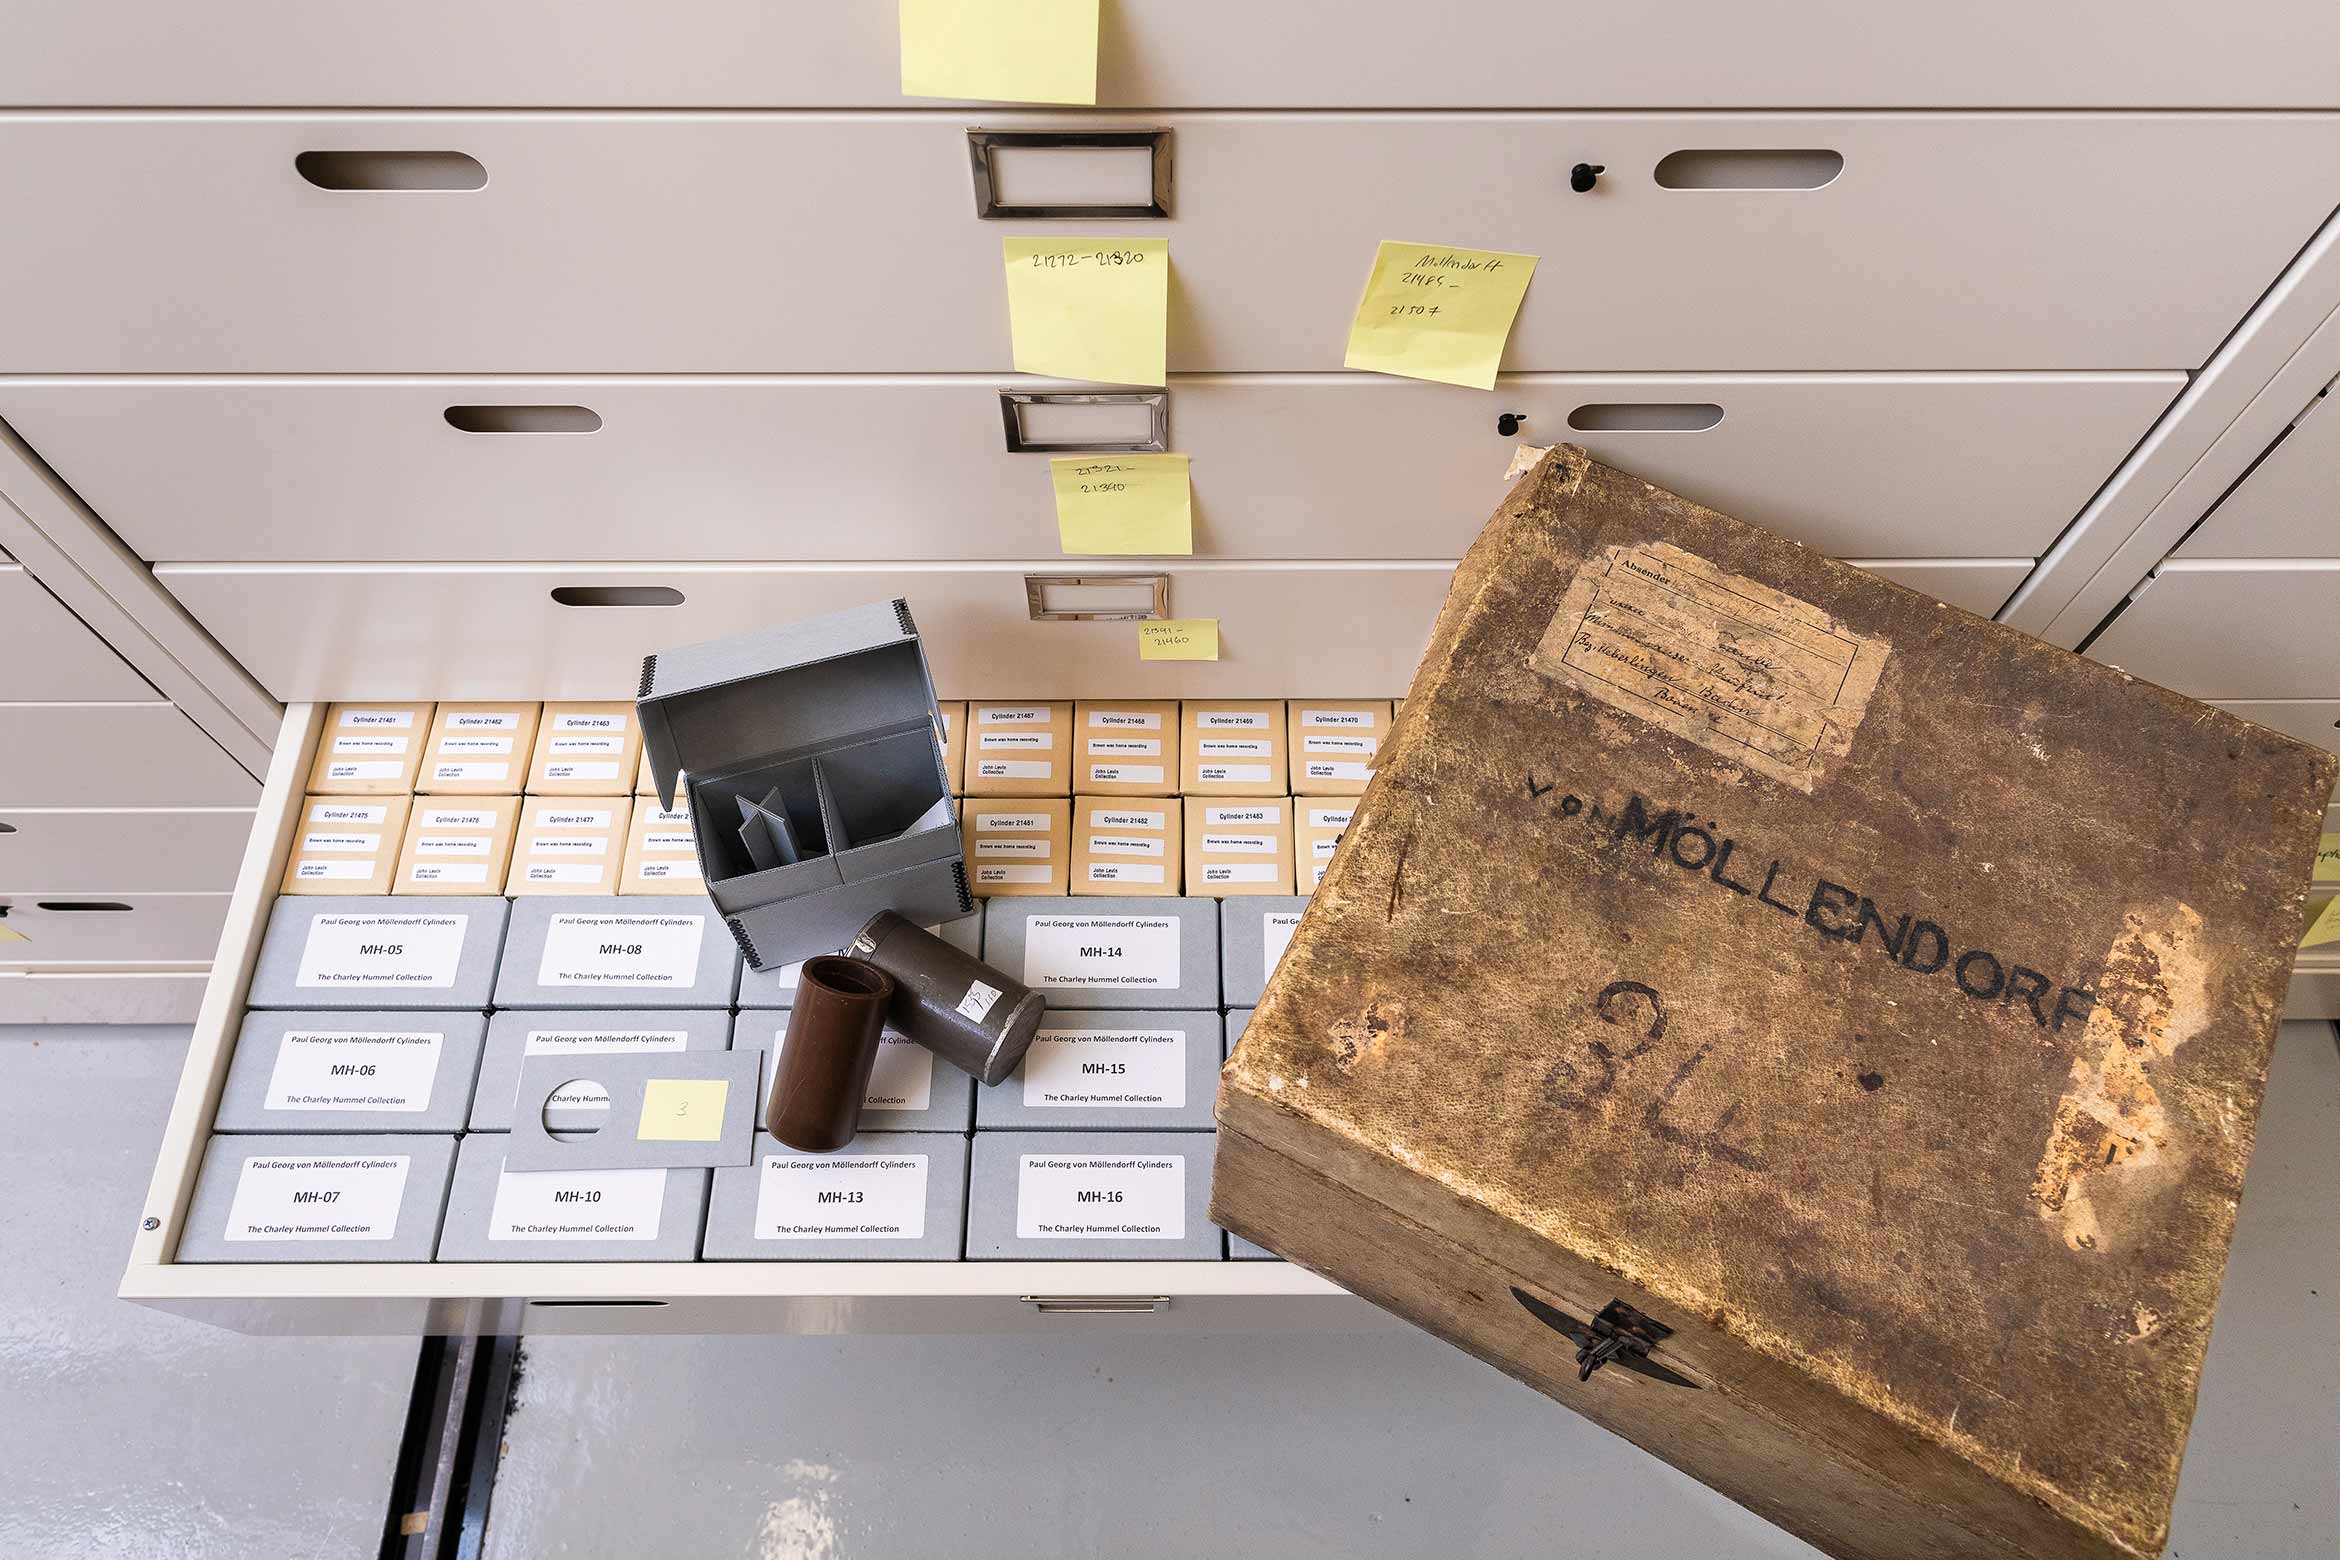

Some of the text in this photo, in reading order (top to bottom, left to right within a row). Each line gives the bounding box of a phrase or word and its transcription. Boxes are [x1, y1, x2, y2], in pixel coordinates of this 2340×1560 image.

[1620, 559, 1671, 585] Absender
[352, 715, 378, 724] Cylinder
[458, 717, 484, 726] Cylinder
[991, 712, 1016, 721] Cylinder
[1102, 716, 1127, 724] Cylinder
[1209, 717, 1235, 725] Cylinder
[1314, 715, 1340, 724] Cylinder
[566, 719, 592, 727] Cylinder
[323, 810, 350, 819] Cylinder
[549, 815, 575, 824] Cylinder
[1218, 813, 1245, 821] Cylinder
[1323, 815, 1348, 823] Cylinder
[435, 816, 460, 824] Cylinder
[989, 819, 1016, 828] Cylinder
[1103, 816, 1129, 825] Cylinder
[320, 918, 338, 926] Paul
[338, 918, 361, 927] Georg
[376, 918, 422, 926] Möllendorff
[422, 918, 457, 927] Cylinders
[558, 917, 576, 925] Paul
[576, 917, 599, 926] Georg
[614, 918, 660, 926] Möllendorff
[659, 918, 694, 927] Cylinders
[1034, 920, 1051, 928] Paul
[1051, 920, 1075, 929] Georg
[1090, 920, 1135, 928] Möllendorff
[1135, 920, 1169, 929] Cylinders
[1272, 918, 1290, 926] Paul
[359, 944, 404, 955] MH-05
[599, 944, 643, 955] MH-08
[1079, 946, 1123, 958] MH-14
[317, 973, 433, 982] The Charley Hummel Collection
[559, 972, 673, 982] The Charley Hummel Collection
[1042, 975, 1158, 985] The Charley Hummel Collection
[291, 1035, 309, 1043] Paul
[309, 1035, 333, 1045] Georg
[349, 1036, 396, 1045] Möllendorff
[396, 1036, 432, 1046] Cylinders
[535, 1035, 553, 1043] Paul
[553, 1035, 578, 1044] Georg
[593, 1034, 640, 1043] Möllendorff
[640, 1035, 676, 1044] Cylinders
[1036, 1035, 1052, 1043] Paul
[1053, 1035, 1076, 1045] Georg
[1093, 1035, 1139, 1043] Möllendorff
[1139, 1035, 1174, 1044] Cylinders
[330, 1064, 377, 1076] MH-06
[1082, 1063, 1126, 1075] MH-15
[287, 1095, 406, 1105] The Charley Hummel Collection
[551, 1095, 611, 1104] Charley Humm
[867, 1096, 906, 1104] Collection
[1043, 1093, 1162, 1103] The Charley Hummel Collection
[252, 1161, 271, 1169] Paul
[271, 1161, 296, 1171] Georg
[312, 1160, 361, 1169] Möllendorff
[361, 1160, 398, 1170] Cylinders
[771, 1161, 789, 1169] Paul
[790, 1161, 815, 1171] Georg
[831, 1160, 880, 1169] Möllendorff
[879, 1160, 916, 1171] Cylinders
[1028, 1160, 1047, 1168] Paul
[1047, 1160, 1072, 1170] Georg
[1088, 1160, 1136, 1169] Möllendorff
[1136, 1160, 1174, 1170] Cylinders
[293, 1191, 341, 1204] MH-07
[554, 1190, 602, 1203] MH-10
[817, 1191, 864, 1204] MH-13
[1077, 1190, 1123, 1203] MH-16
[247, 1224, 371, 1235] The Charley Hummel Collection
[511, 1224, 635, 1235] The Charley Hummel Collection
[776, 1224, 900, 1235] The Charley Hummel Collection
[1037, 1224, 1161, 1234] The Charley Hummel Collection
